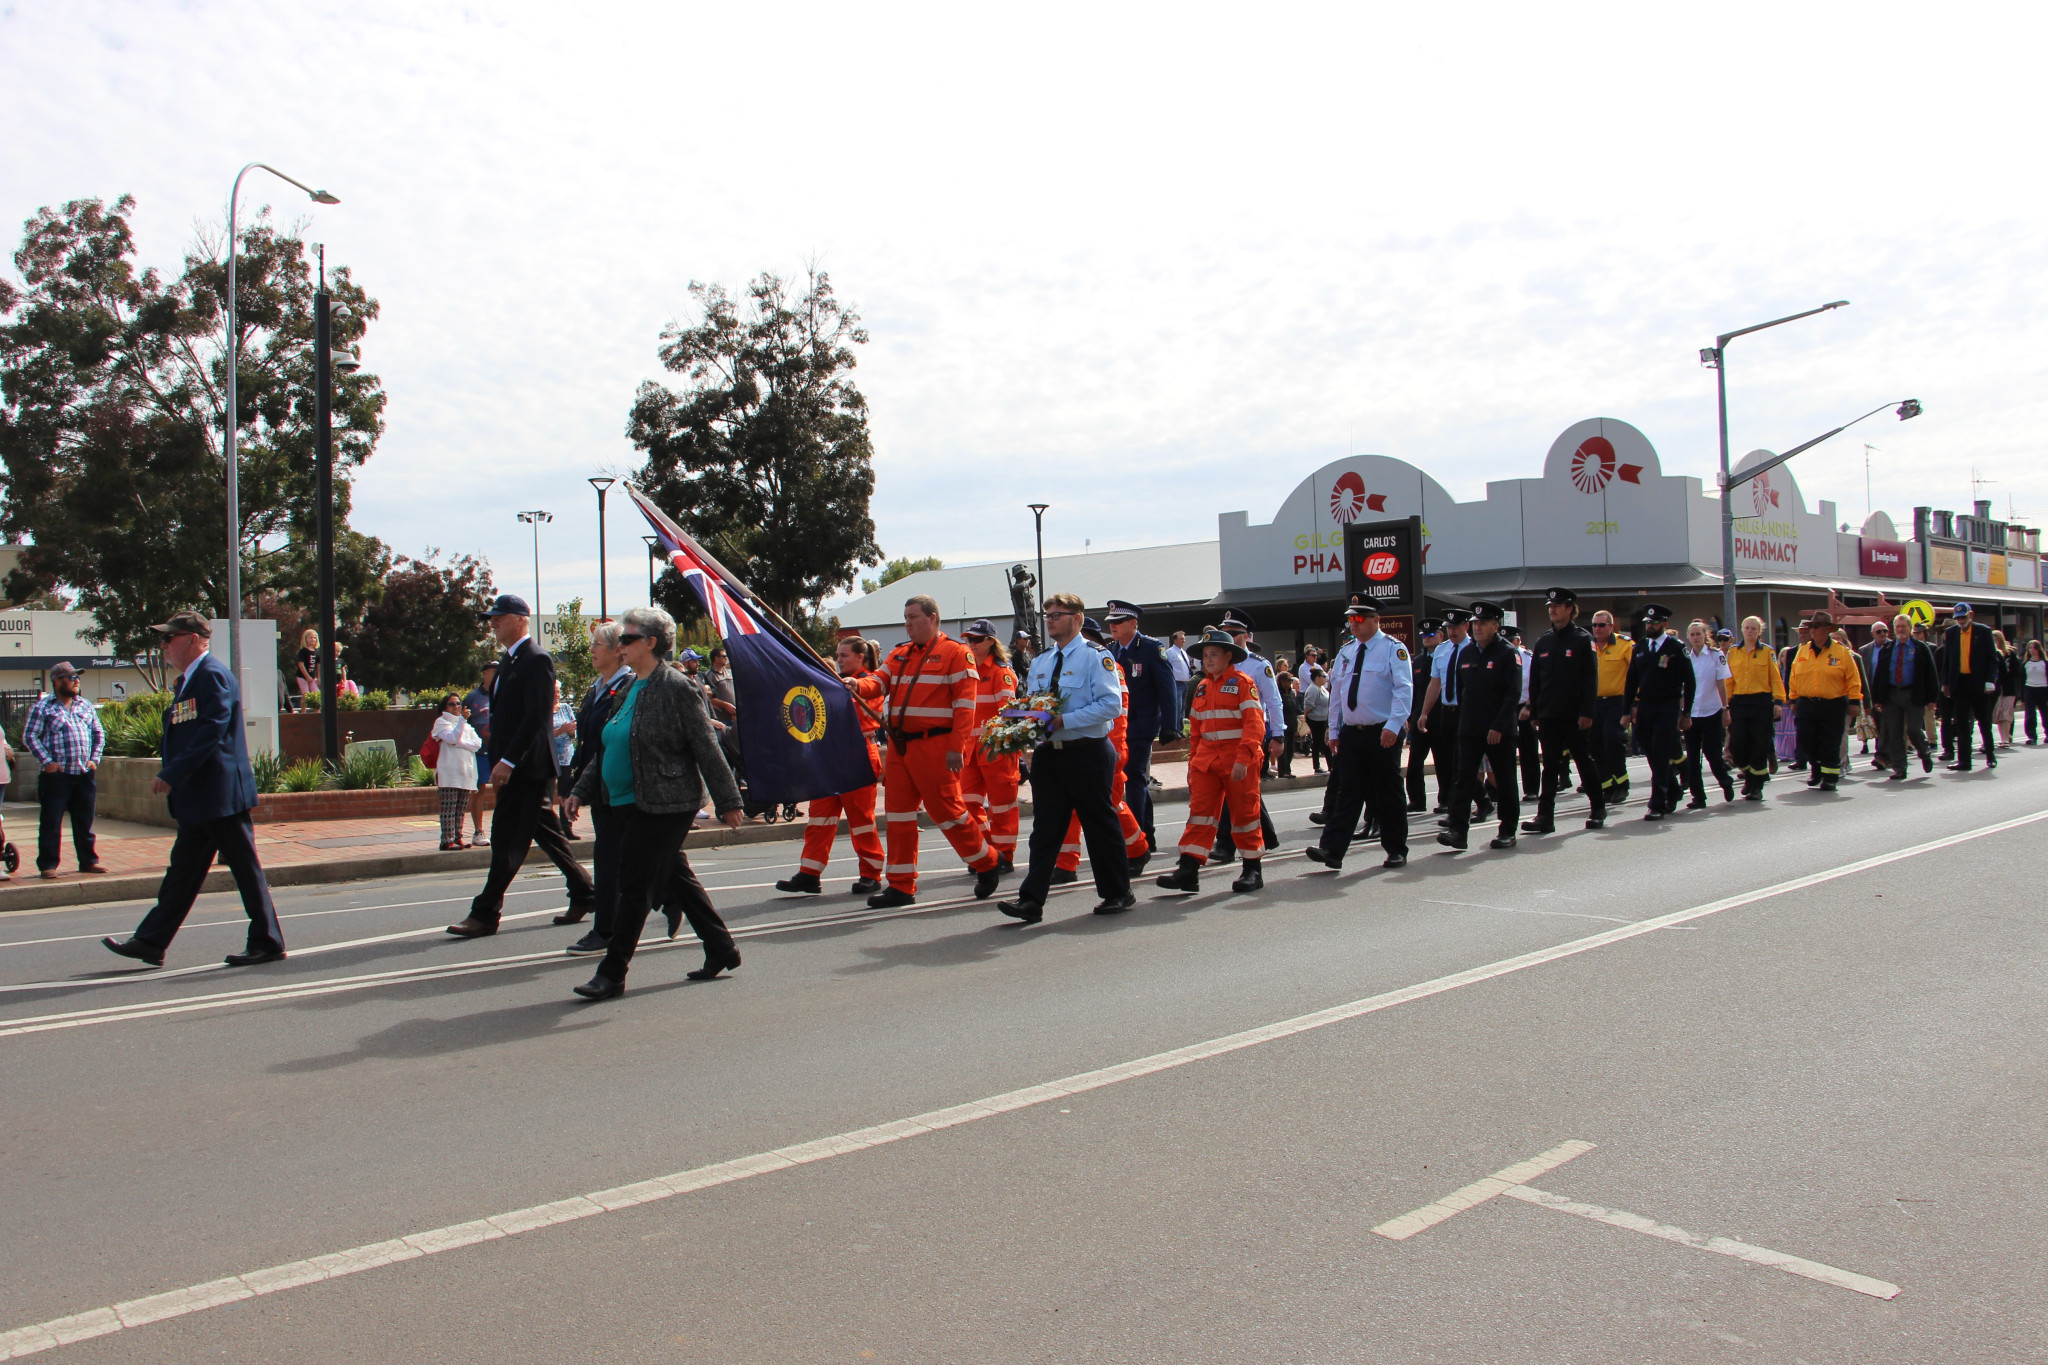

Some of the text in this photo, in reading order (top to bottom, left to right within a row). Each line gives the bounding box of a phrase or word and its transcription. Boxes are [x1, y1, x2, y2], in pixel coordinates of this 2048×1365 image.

[1586, 521, 1619, 534] 2011
[1735, 517, 1798, 539] GILGANDRA
[1363, 535, 1397, 549] CARLO'S
[1734, 537, 1798, 564] PHARMACY
[1366, 557, 1396, 575] IGA
